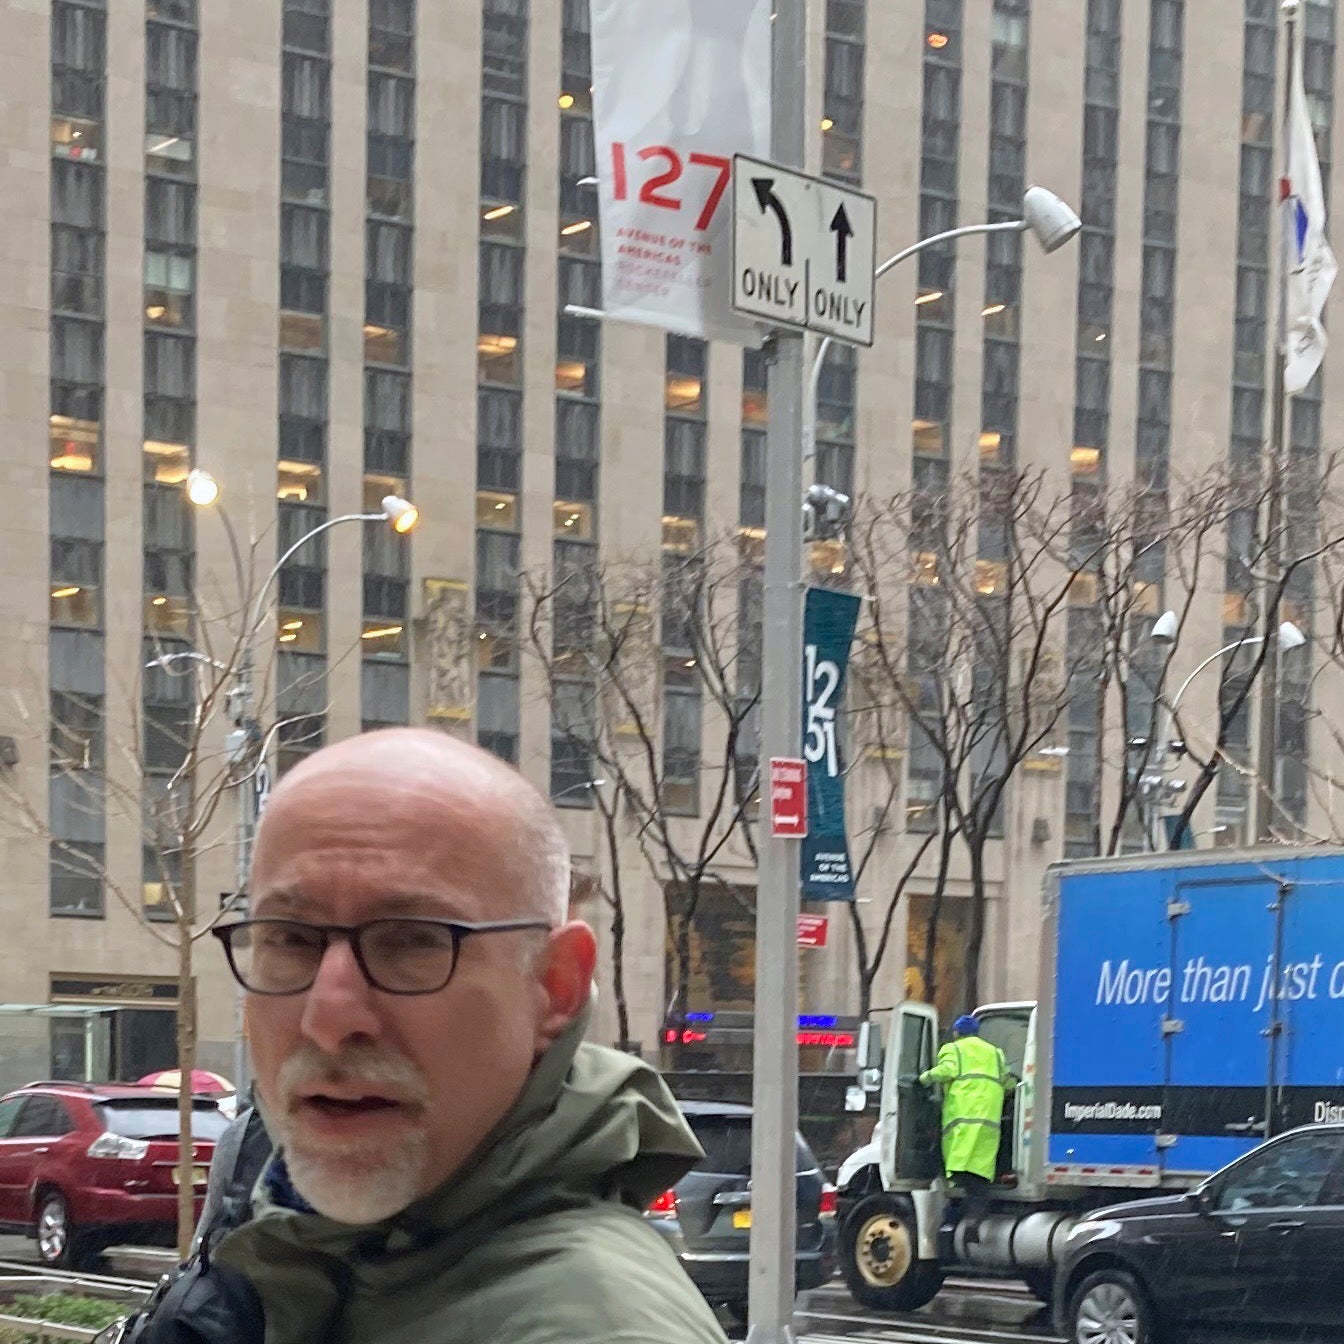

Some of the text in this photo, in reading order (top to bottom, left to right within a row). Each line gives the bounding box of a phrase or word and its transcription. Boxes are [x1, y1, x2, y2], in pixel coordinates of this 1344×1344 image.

[611, 141, 732, 232] 127
[616, 226, 667, 247] AVENUE
[617, 244, 682, 267] AMERICAS
[742, 266, 800, 309] ONLY
[814, 287, 866, 329] ONLY
[804, 645, 840, 721] 12
[804, 705, 838, 778] 51
[1094, 957, 1172, 1007] More
[1180, 955, 1252, 1004] than
[1063, 1101, 1162, 1123] ImperialDade.com
